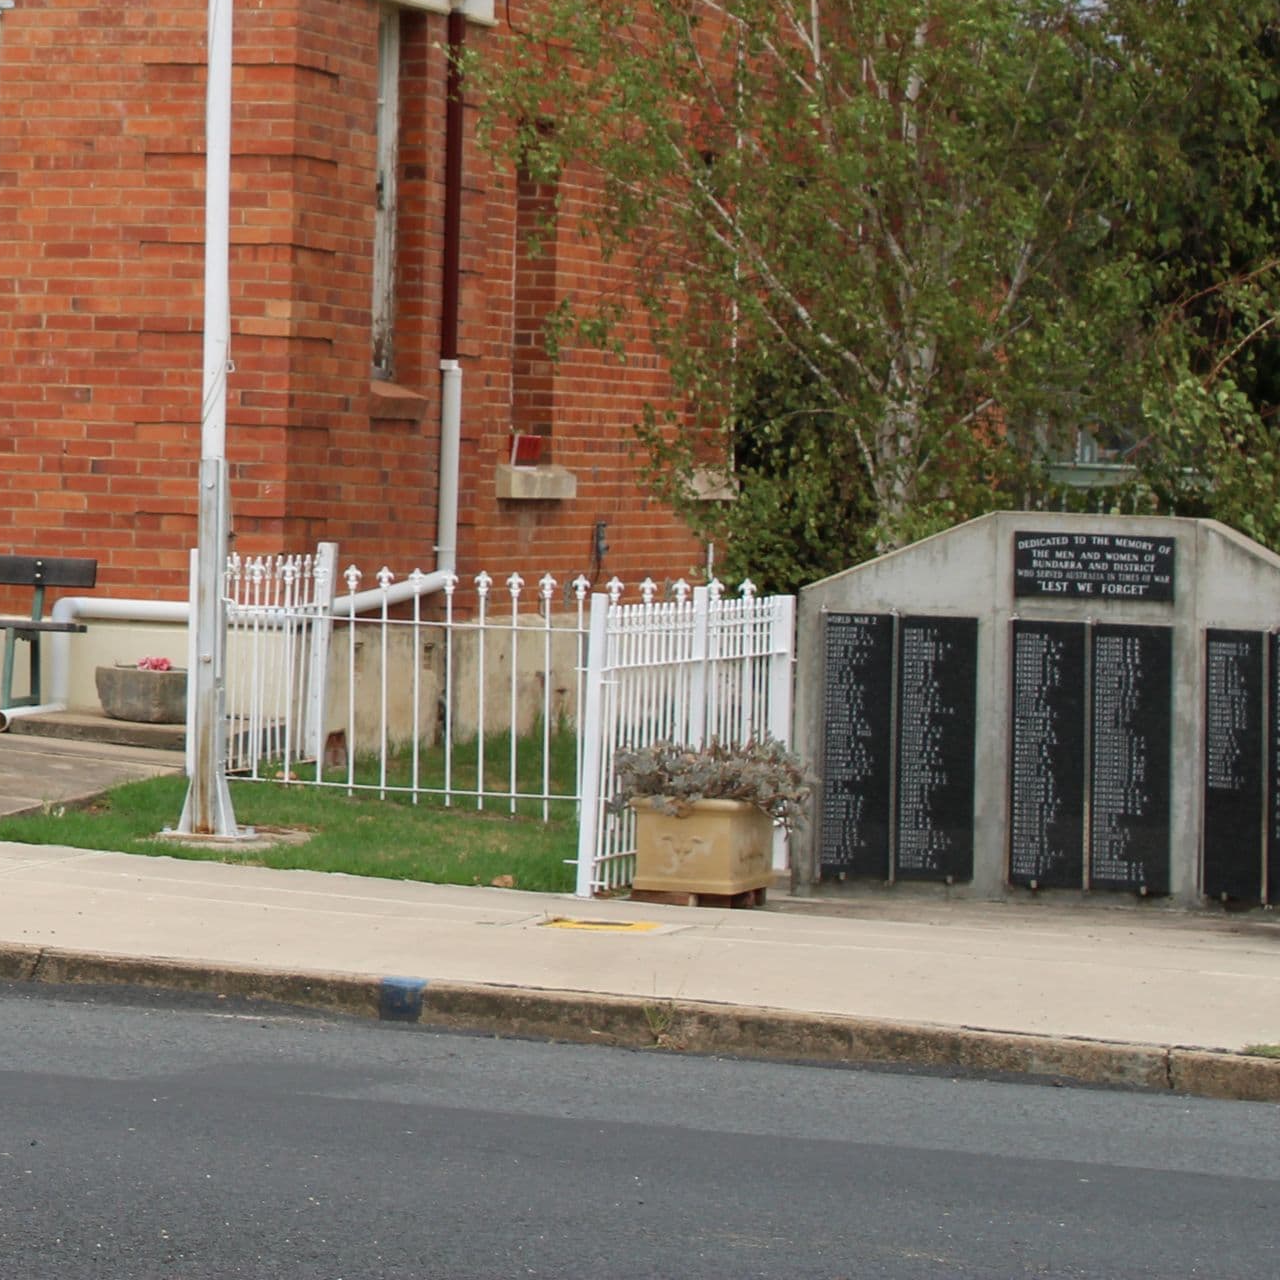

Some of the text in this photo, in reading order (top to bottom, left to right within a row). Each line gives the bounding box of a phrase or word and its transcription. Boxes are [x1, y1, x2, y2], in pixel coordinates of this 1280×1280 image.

[1017, 536, 1172, 555] DEDICATED TO THE MEMORY OF
[1031, 549, 1156, 563] THE MEN AND WOMEN OF
[1032, 559, 1157, 573] BUNDARRA AND DISTRICT
[1036, 570, 1064, 579] SERVED
[1065, 571, 1105, 581] AUSTRALIA
[1118, 573, 1140, 582] TIMES
[1154, 575, 1170, 584] WAR
[1077, 582, 1093, 593] WE
